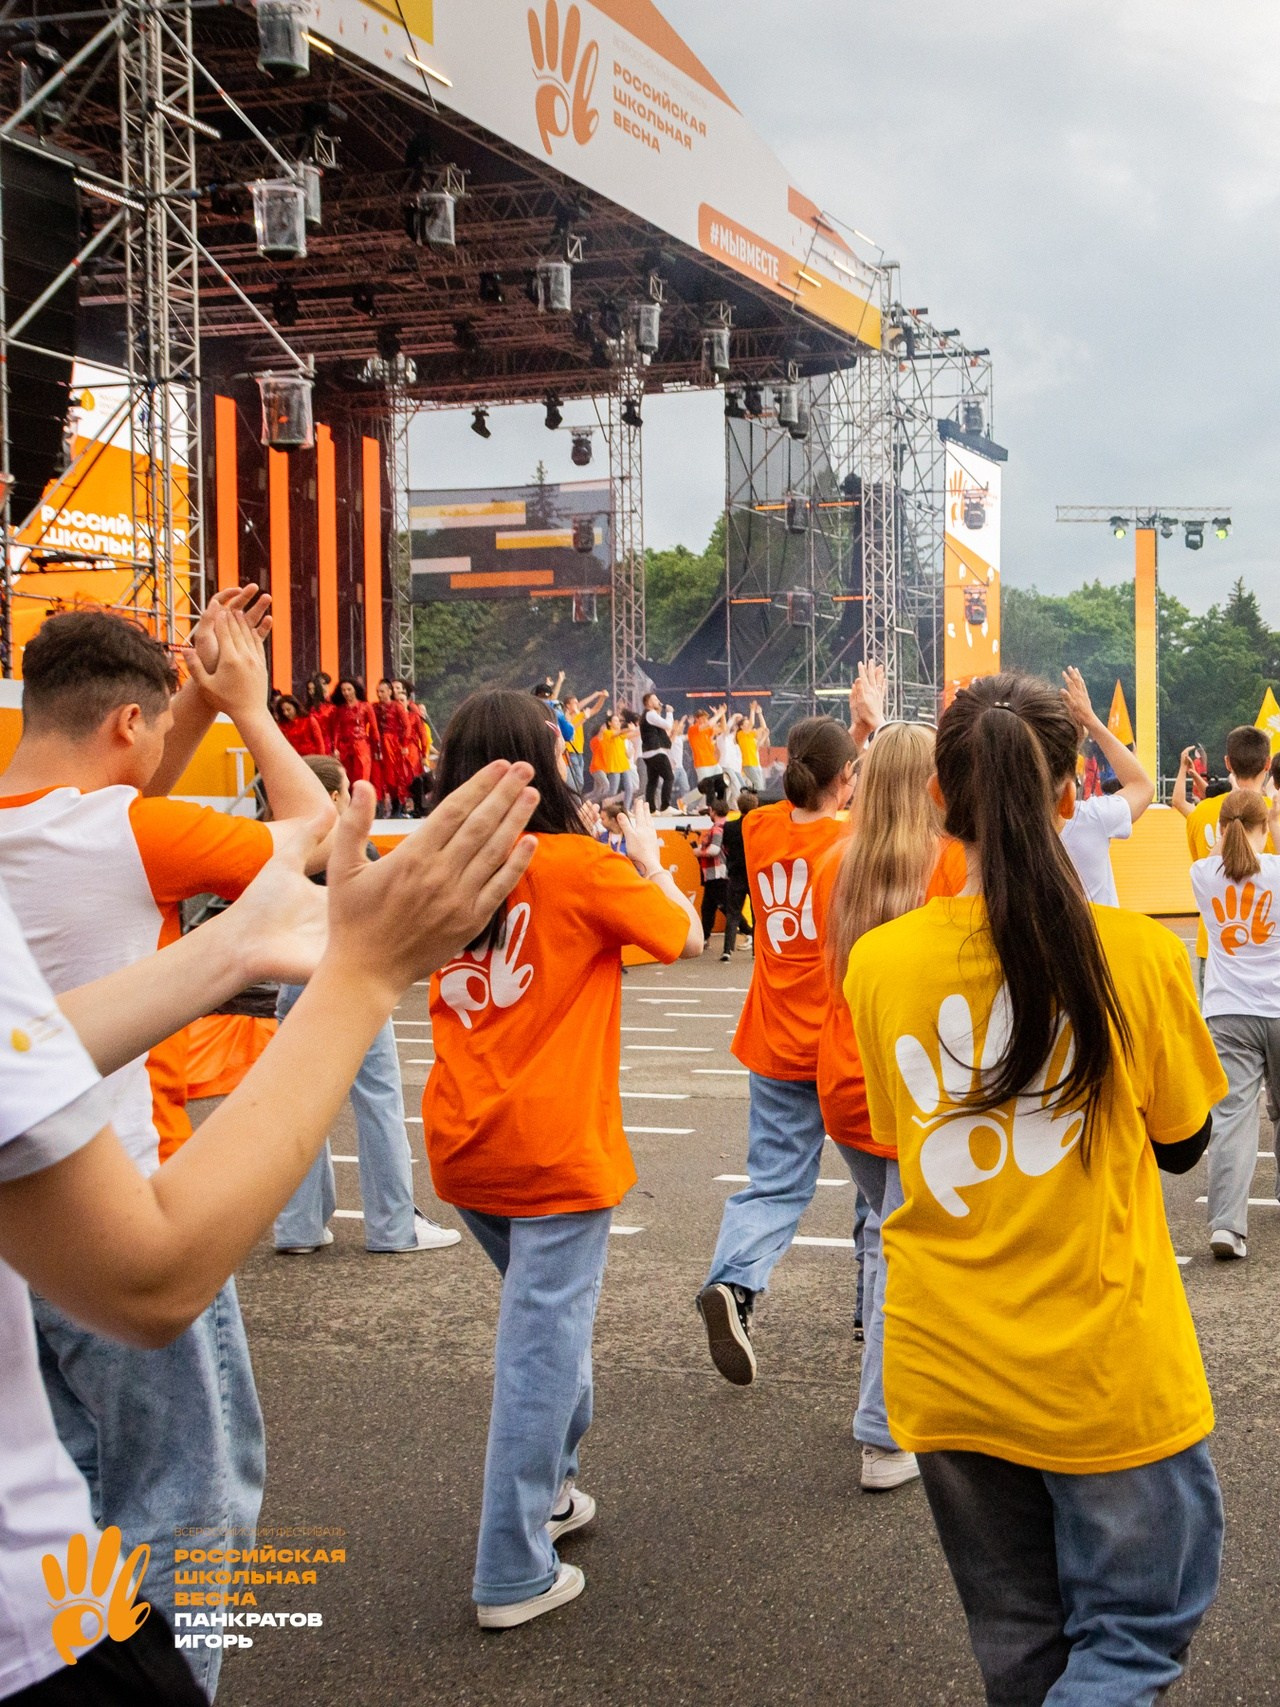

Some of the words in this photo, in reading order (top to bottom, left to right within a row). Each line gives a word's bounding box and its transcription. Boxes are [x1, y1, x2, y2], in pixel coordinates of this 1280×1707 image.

[613, 60, 707, 137] РОССИЙСКАЯ
[613, 84, 692, 150] ШКОЛЬНАЯ
[613, 109, 661, 154] ВЕСНА
[710, 221, 780, 281] #МЫВМЕСТЕ
